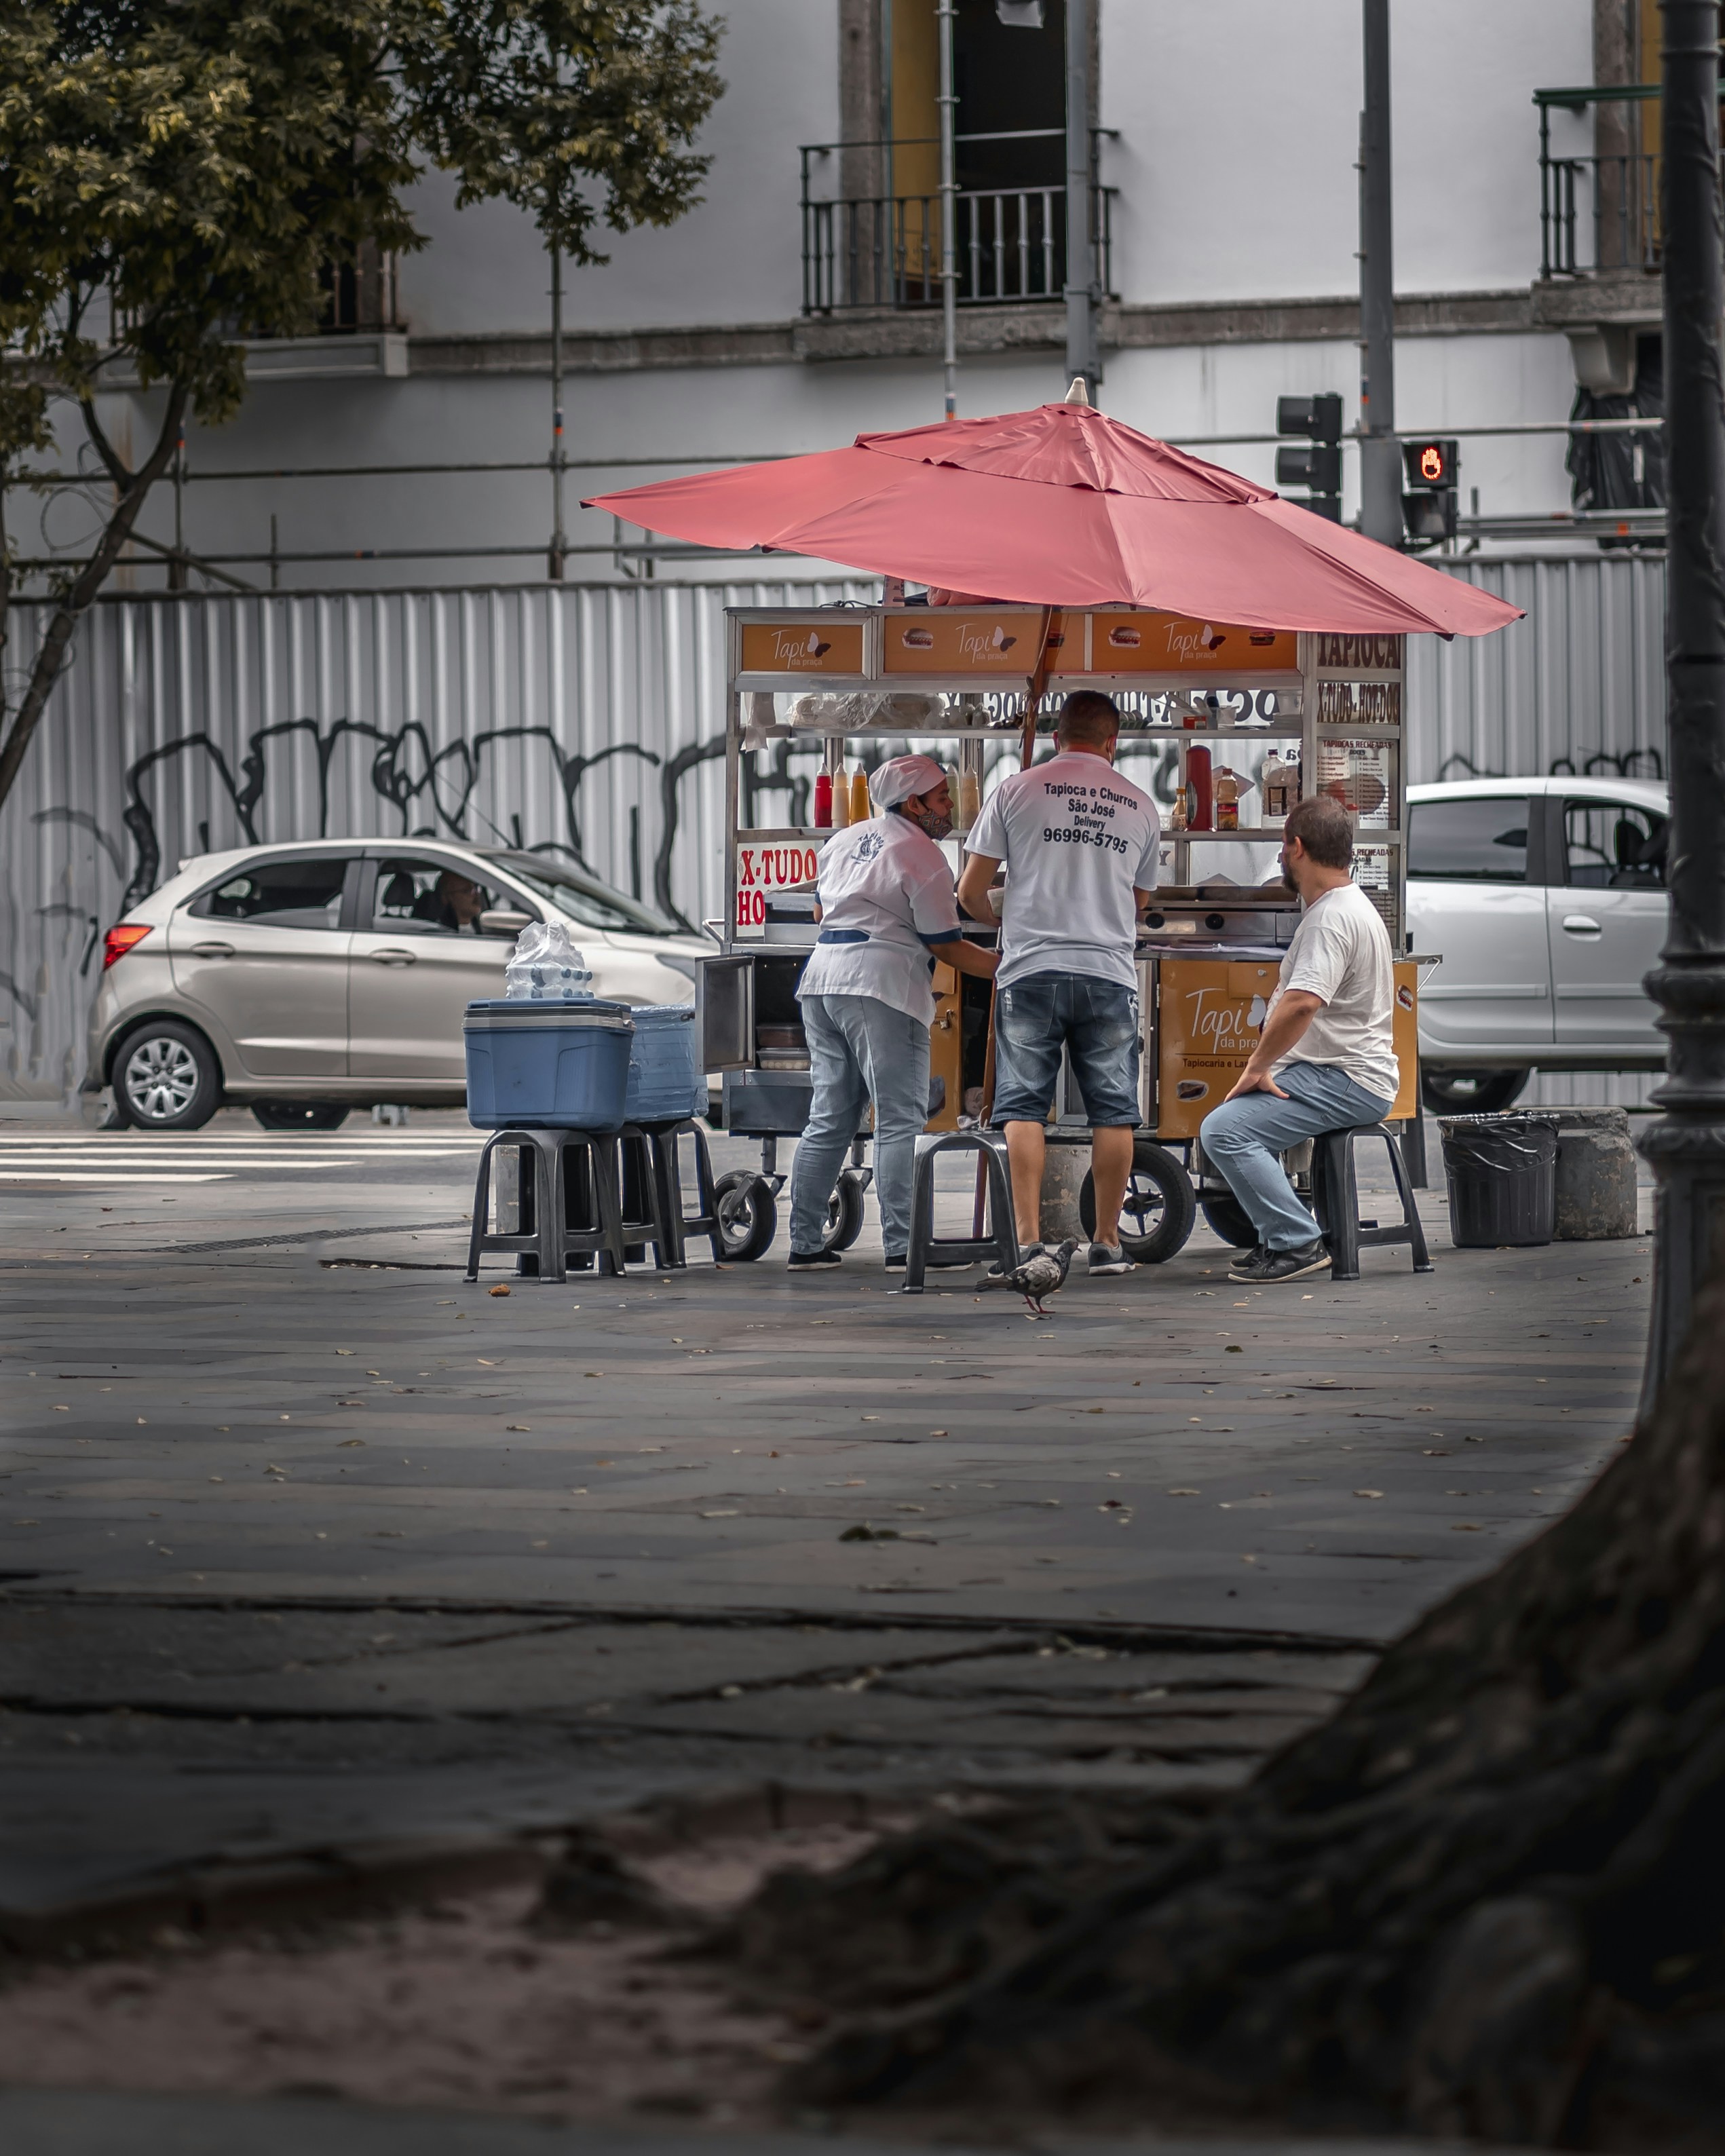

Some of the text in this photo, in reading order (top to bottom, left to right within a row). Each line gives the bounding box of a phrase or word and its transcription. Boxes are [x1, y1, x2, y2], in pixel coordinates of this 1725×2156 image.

[771, 629, 806, 669] Tapi
[955, 623, 991, 664] Tapi
[1163, 621, 1200, 663] Tapi
[1318, 632, 1399, 668] TAPIOCA
[802, 659, 823, 667] praça
[987, 654, 1008, 662] praça
[1184, 650, 1217, 660] da praça
[1323, 740, 1354, 748] TAPIOCAS
[1044, 782, 1138, 810] Tapioca e Churros
[1068, 798, 1115, 818] São José
[1074, 815, 1106, 832] Delivery
[1043, 827, 1129, 854] 96996-5795
[1357, 848, 1394, 856] RECHEADAS
[741, 848, 817, 886] X-TUDO
[738, 890, 765, 926] HO
[1185, 987, 1244, 1055] Tapi
[1220, 1036, 1258, 1051] da pra
[1183, 1058, 1225, 1069] Tapiocaria
